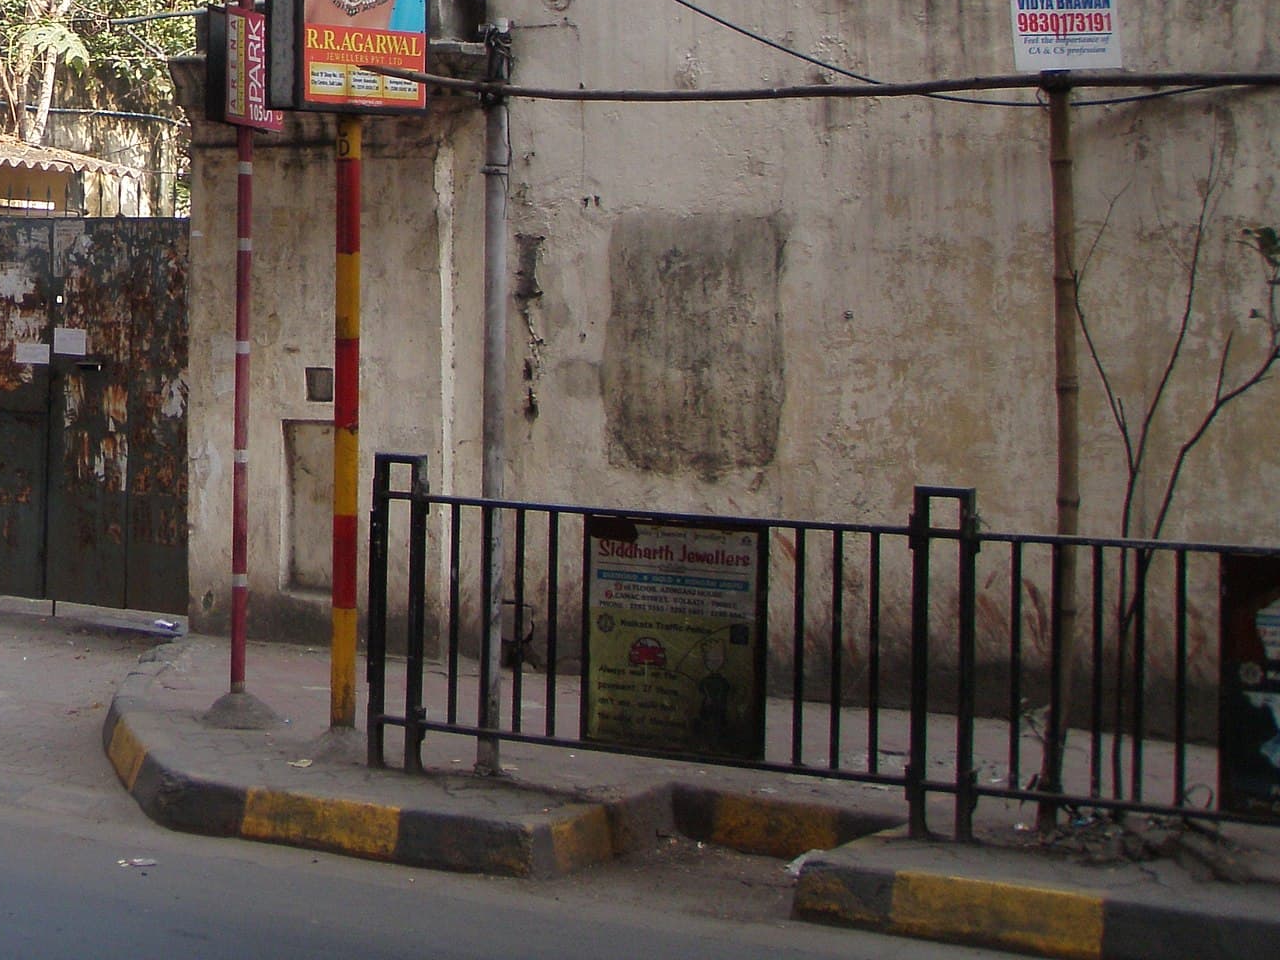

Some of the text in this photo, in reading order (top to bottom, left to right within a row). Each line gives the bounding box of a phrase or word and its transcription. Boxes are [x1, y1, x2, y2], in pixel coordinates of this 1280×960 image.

[1017, 13, 1112, 32] 9830173191
[248, 19, 262, 102] PARK
[598, 540, 751, 567] Siddharth Jewellers
[656, 622, 683, 632] Traffic
